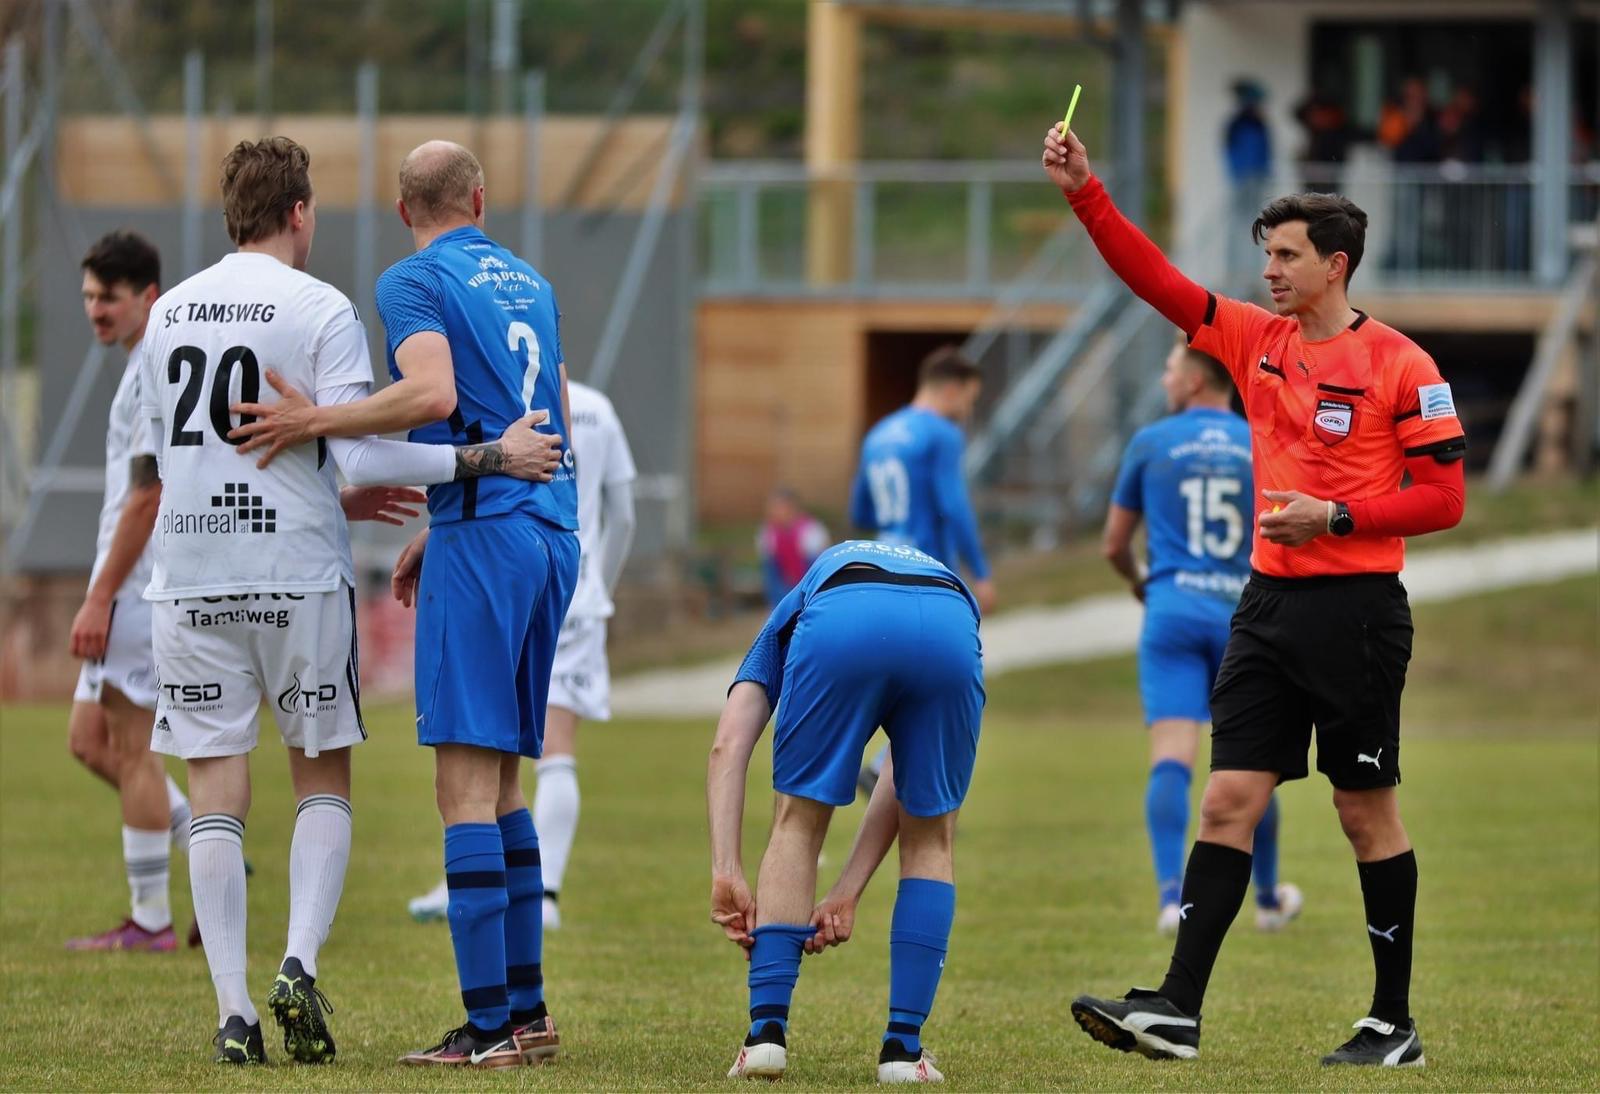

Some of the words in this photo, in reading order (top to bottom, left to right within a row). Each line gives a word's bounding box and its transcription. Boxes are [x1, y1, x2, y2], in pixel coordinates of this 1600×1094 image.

[165, 305, 182, 328] SC
[187, 303, 276, 323] TAMSWEG
[168, 345, 260, 447] 20
[507, 321, 551, 426] 2
[1180, 477, 1243, 559] 15
[164, 683, 222, 703] TSD
